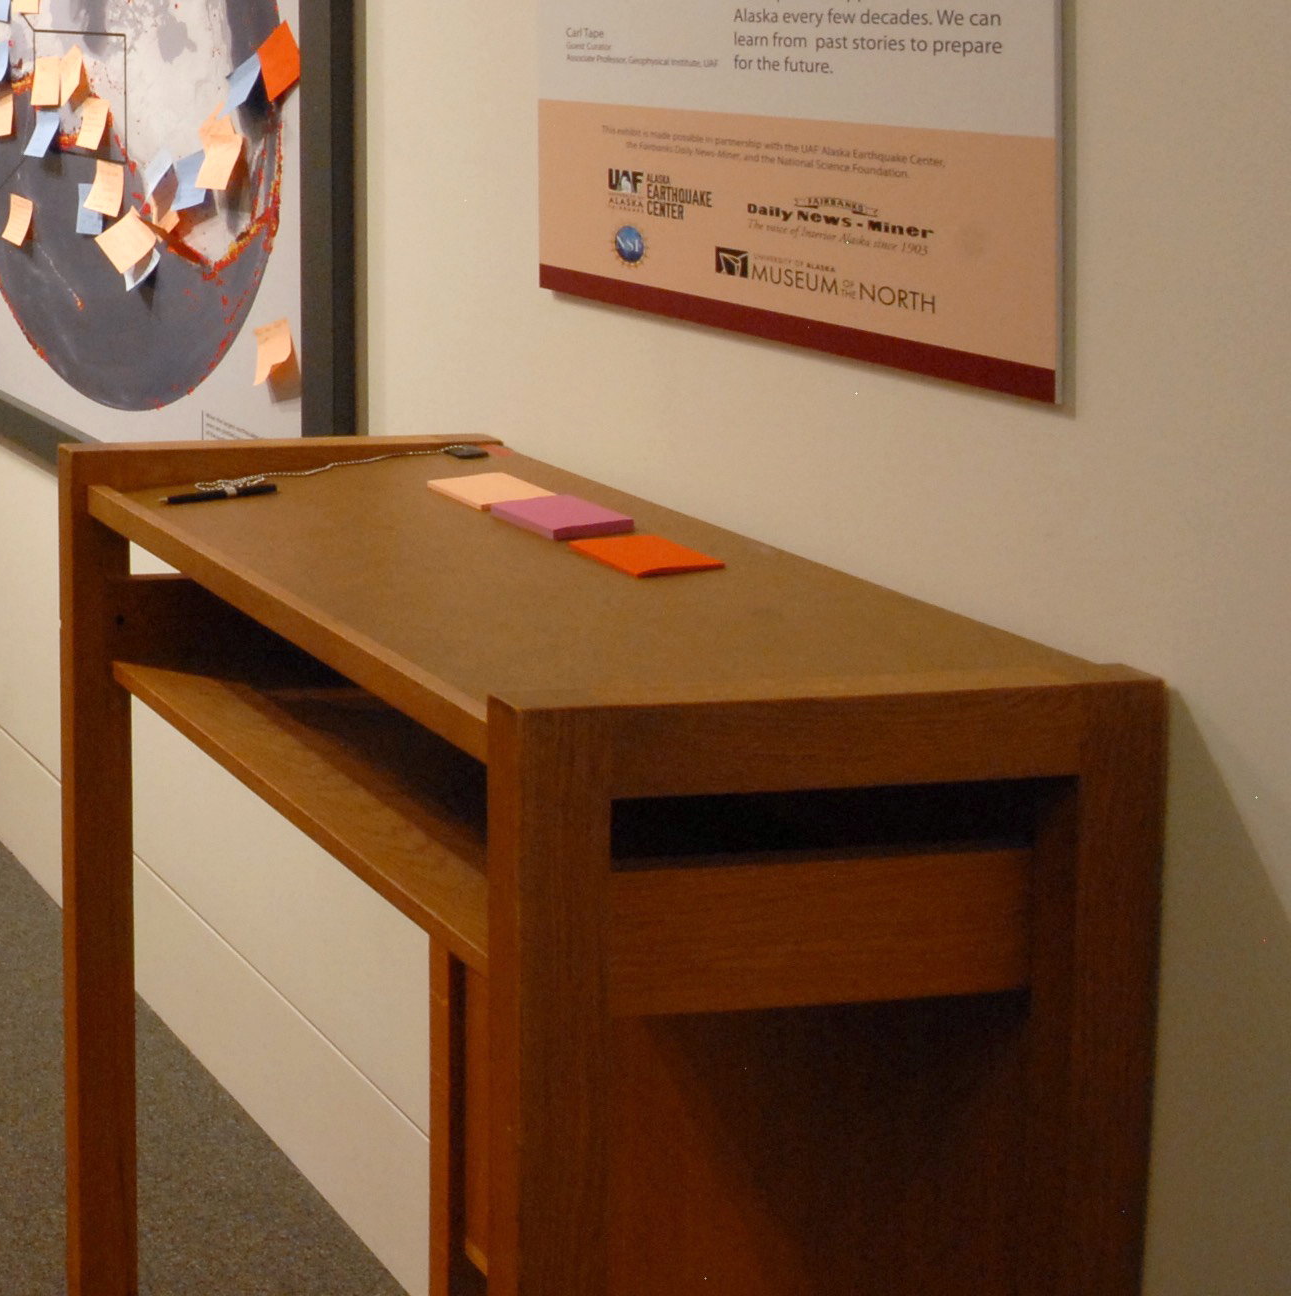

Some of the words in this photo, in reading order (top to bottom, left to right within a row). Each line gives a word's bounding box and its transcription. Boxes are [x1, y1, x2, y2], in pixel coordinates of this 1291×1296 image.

[607, 168, 643, 193] UAF
[646, 173, 671, 184] ALASKA
[646, 184, 713, 208] EARTHQUAKE
[646, 201, 684, 220] CENTER
[747, 203, 793, 221] Daily
[797, 210, 852, 228] News
[867, 219, 935, 239] Miner
[751, 265, 839, 296] MUSEUM
[859, 282, 936, 314] NORTH
